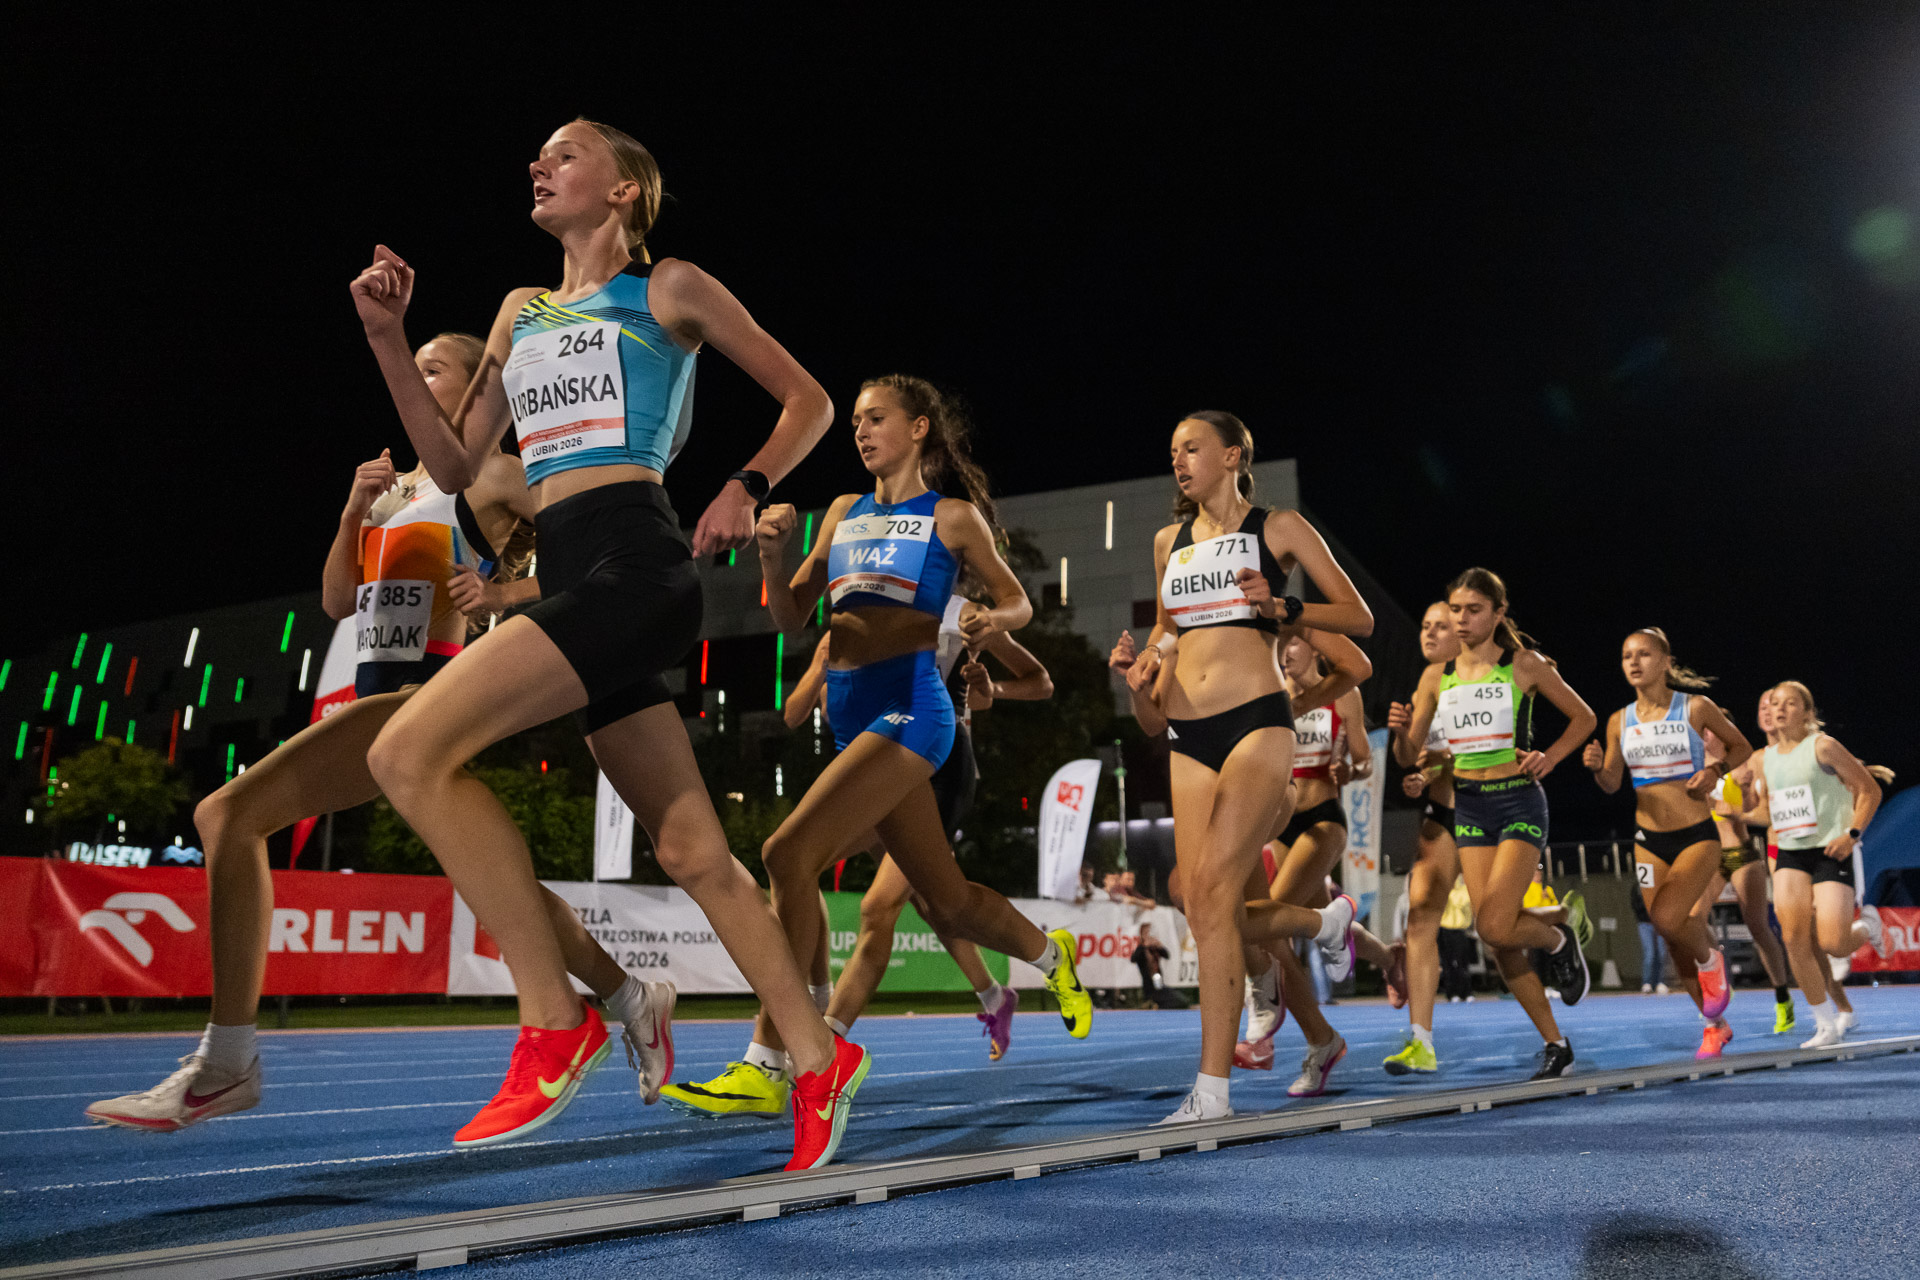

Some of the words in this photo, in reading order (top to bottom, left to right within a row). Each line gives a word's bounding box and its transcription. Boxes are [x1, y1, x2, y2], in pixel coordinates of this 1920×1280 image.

[557, 328, 605, 358] 264
[512, 374, 618, 423] URBAŃSKA
[532, 442, 558, 457] LUBIN
[559, 436, 583, 450] 2026
[885, 520, 922, 536] 702
[848, 543, 898, 568] WĄŻ
[1215, 538, 1249, 556] 771
[863, 582, 886, 592] 2026
[1171, 569, 1237, 596] BIENIA
[380, 586, 421, 606] 385
[1190, 614, 1214, 622] LUBIN
[1215, 609, 1233, 619] 2026
[1474, 687, 1504, 700] 455
[1454, 711, 1493, 729] LATO
[1654, 724, 1685, 735] 1210
[1480, 782, 1507, 792] NIKE
[1785, 788, 1805, 799] 969
[1639, 867, 1649, 885] 2
[269, 908, 425, 953] RLEN
[588, 929, 668, 944] TRZOSTWA
[625, 951, 669, 968] 2026
